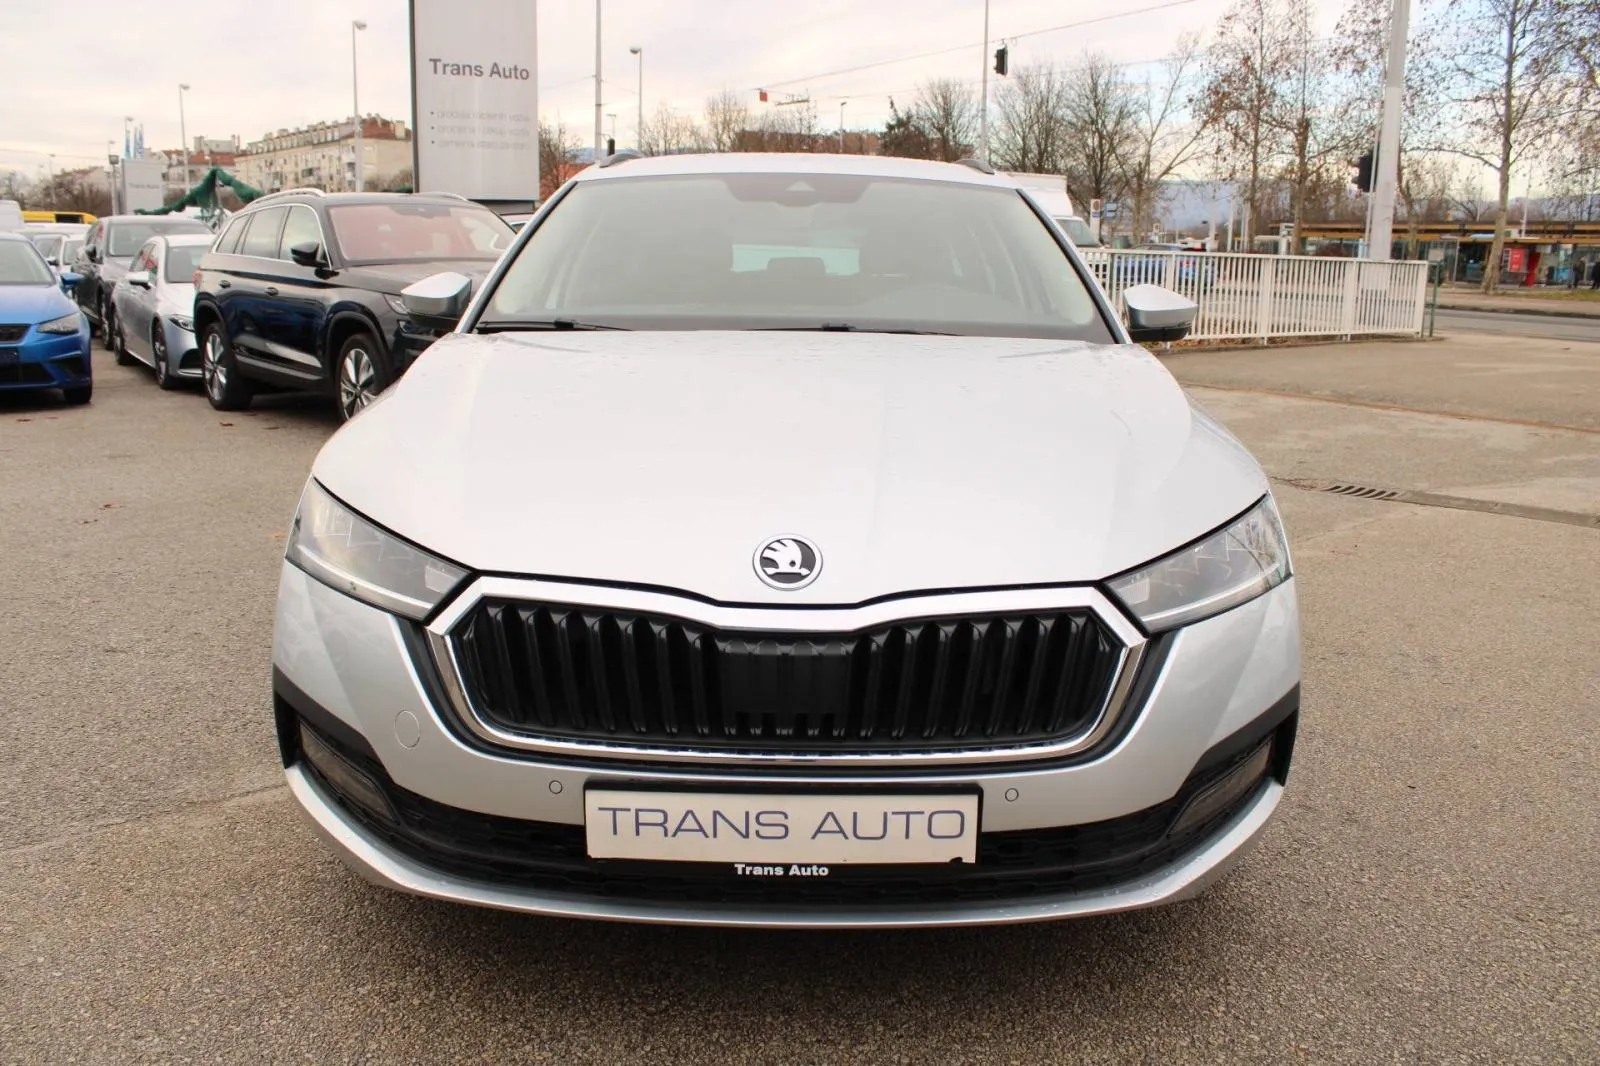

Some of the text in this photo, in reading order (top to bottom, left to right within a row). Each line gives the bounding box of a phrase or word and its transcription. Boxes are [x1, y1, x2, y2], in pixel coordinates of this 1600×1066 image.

[429, 58, 529, 80] Trans Auto
[598, 807, 965, 840] TRANS AUTO
[735, 864, 829, 876] Trans Auto
